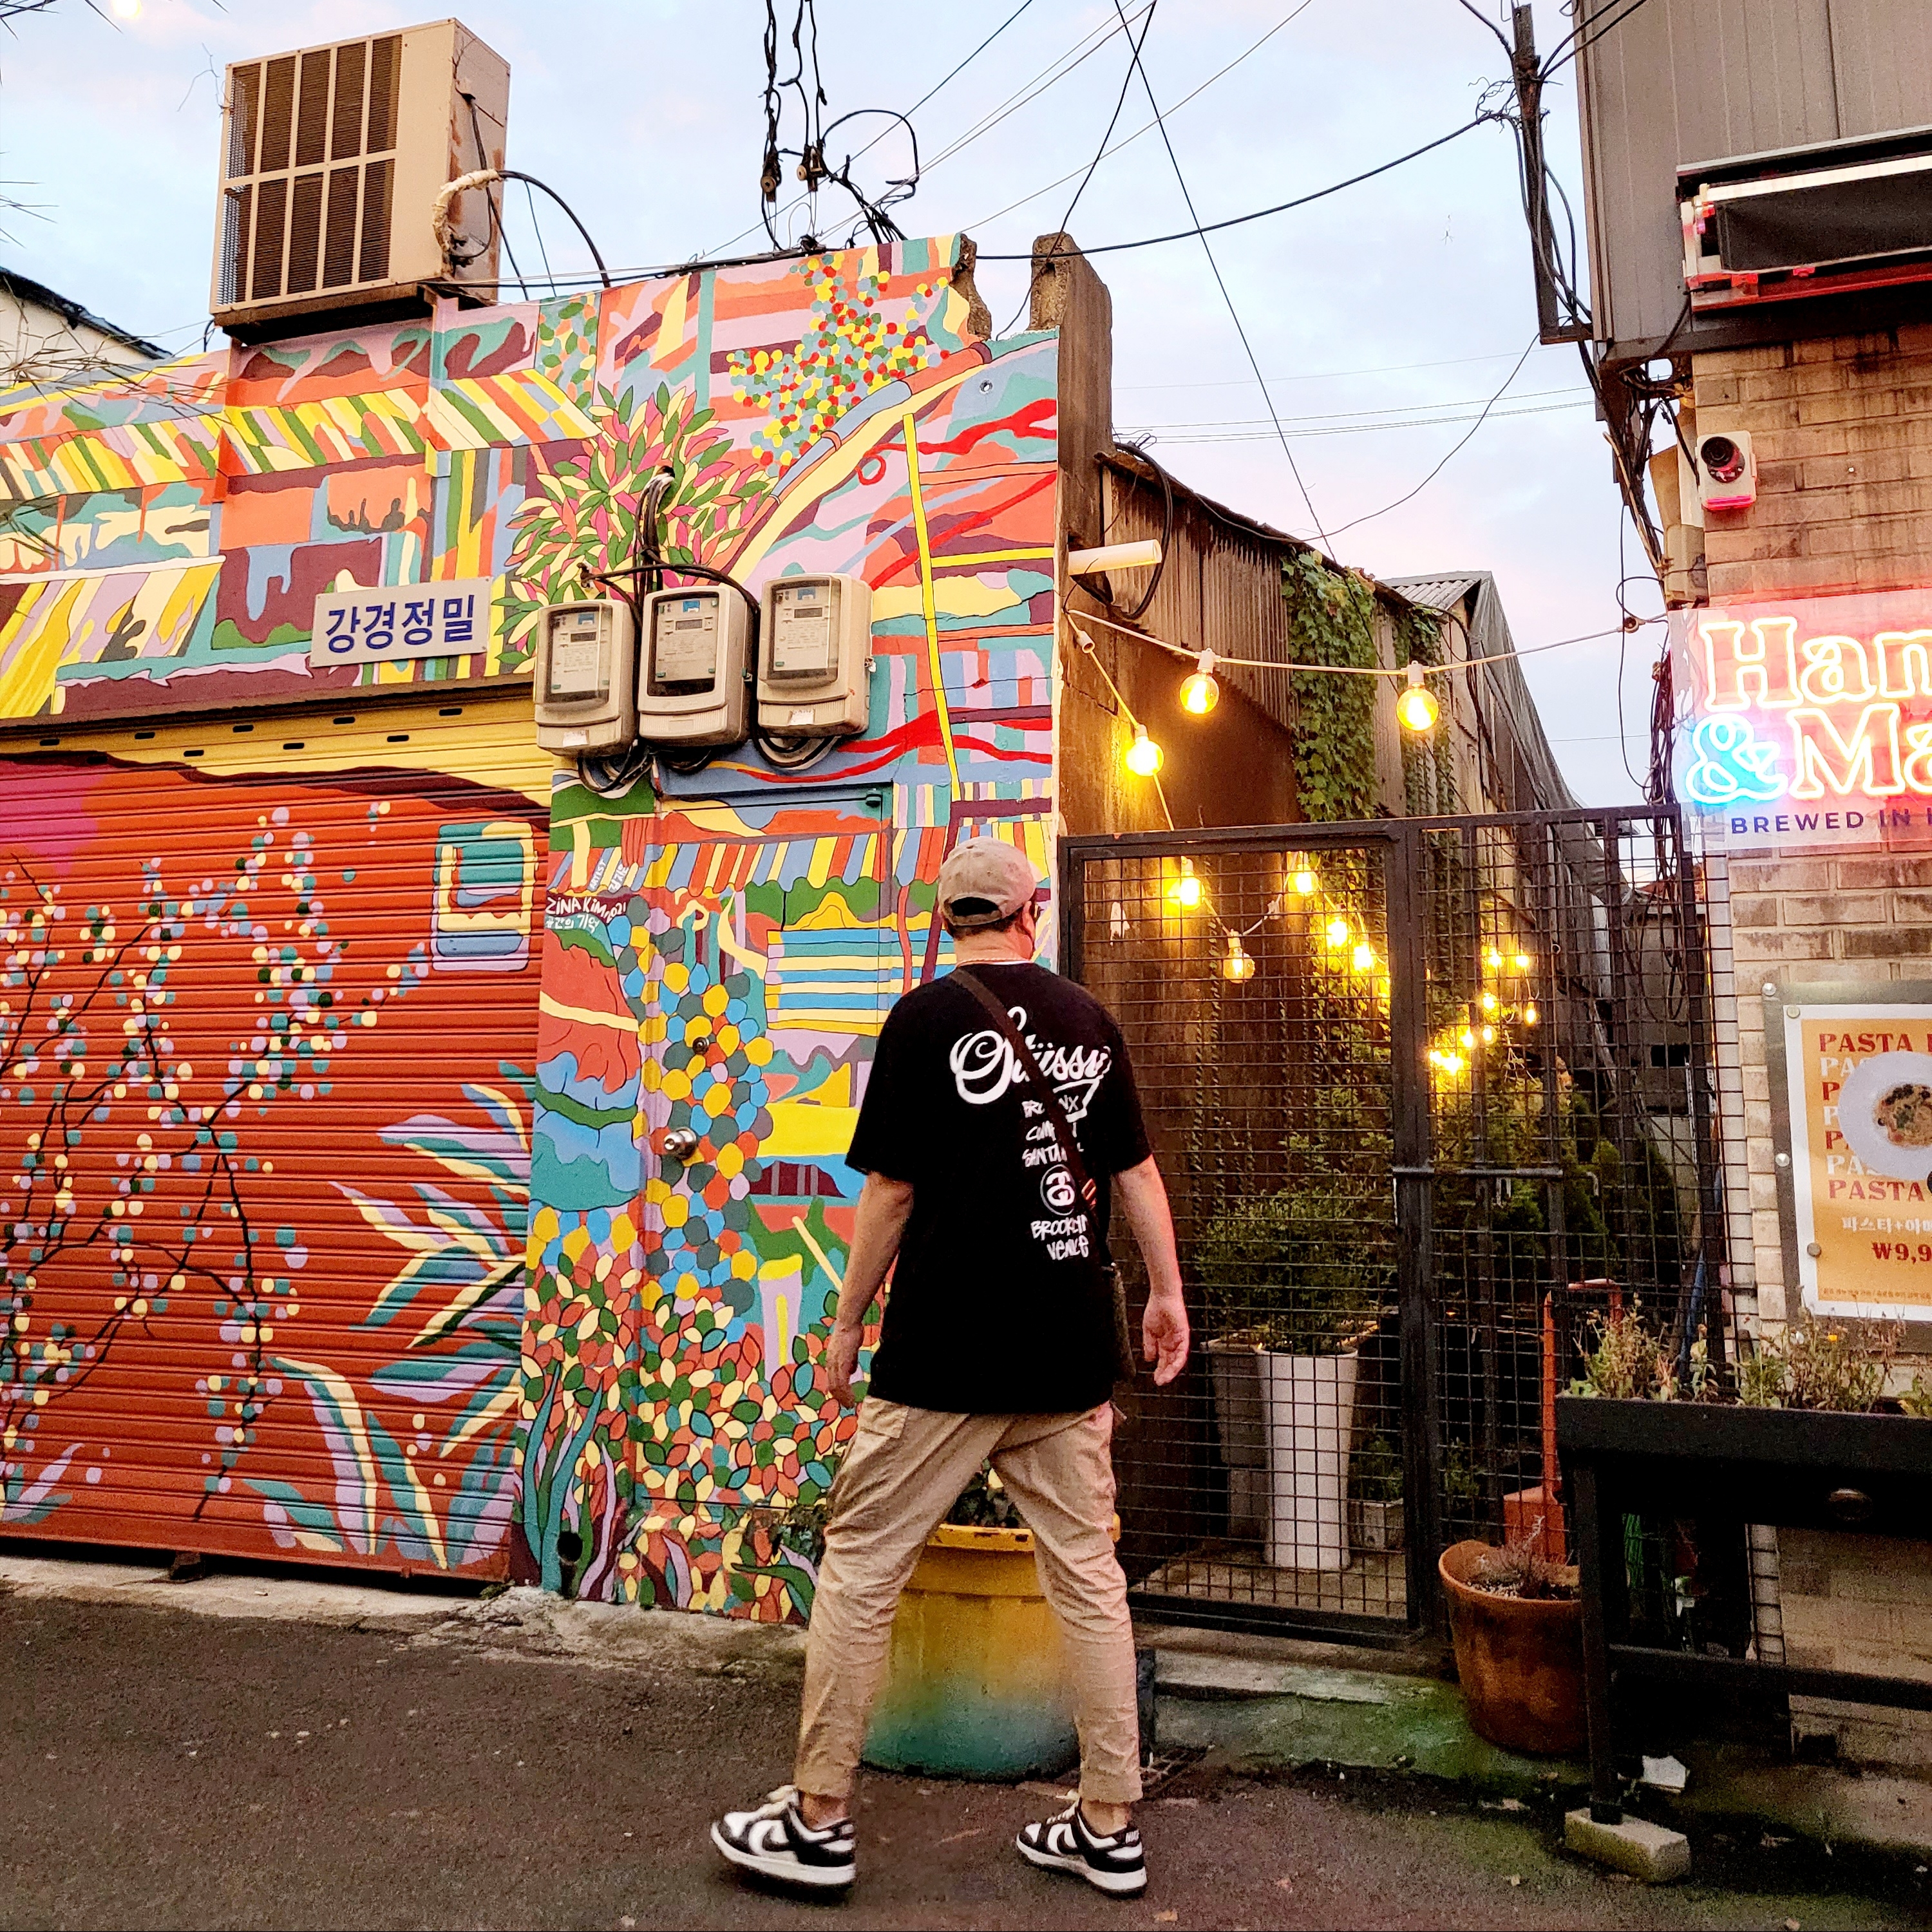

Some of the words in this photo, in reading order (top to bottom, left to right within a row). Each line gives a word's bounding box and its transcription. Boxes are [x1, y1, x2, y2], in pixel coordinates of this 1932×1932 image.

[325, 594, 475, 653] 강경정밀
[1731, 811, 1864, 834] BREWED
[1879, 808, 1910, 828] IN
[1819, 1033, 1913, 1052] PASTA
[1828, 1179, 1925, 1202] PASTA
